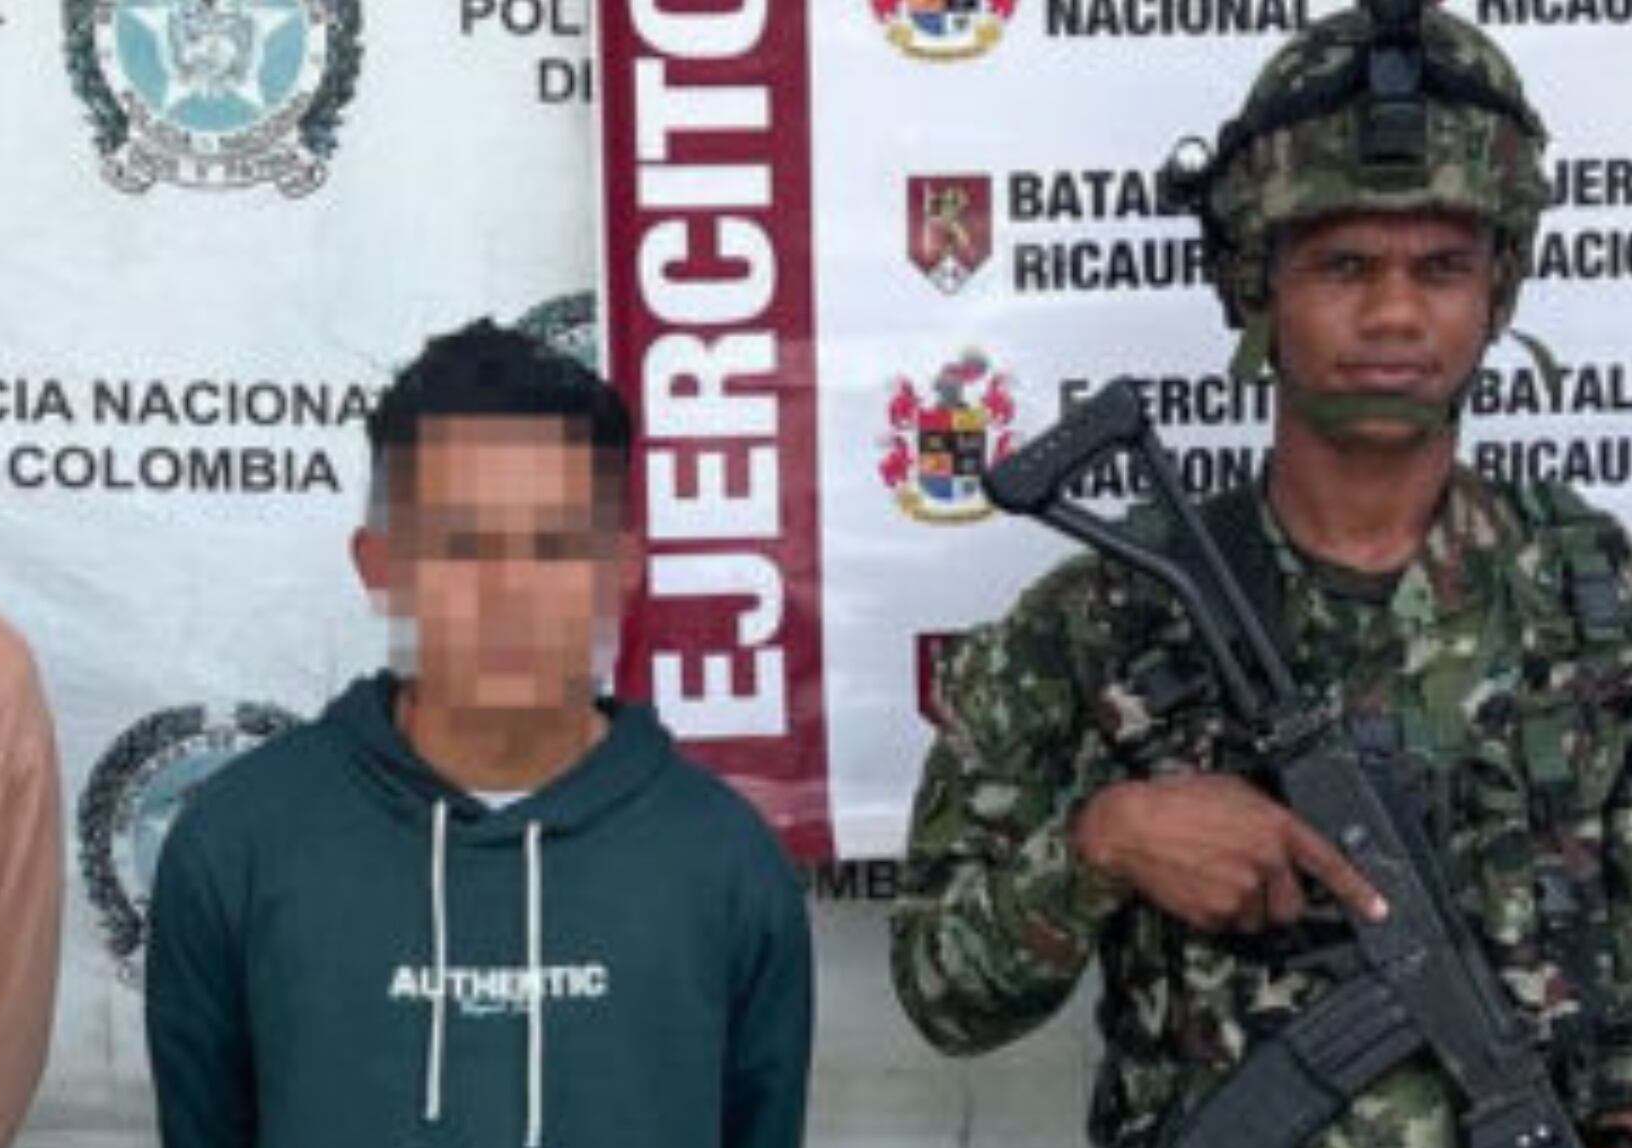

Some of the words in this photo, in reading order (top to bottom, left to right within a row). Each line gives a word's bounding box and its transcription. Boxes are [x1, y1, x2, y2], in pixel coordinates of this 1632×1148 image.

[1538, 231, 1632, 281] ACI
[630, 0, 789, 741] EJERCITO
[92, 378, 381, 427] NACIONA
[7, 444, 342, 493] COLOMBIA
